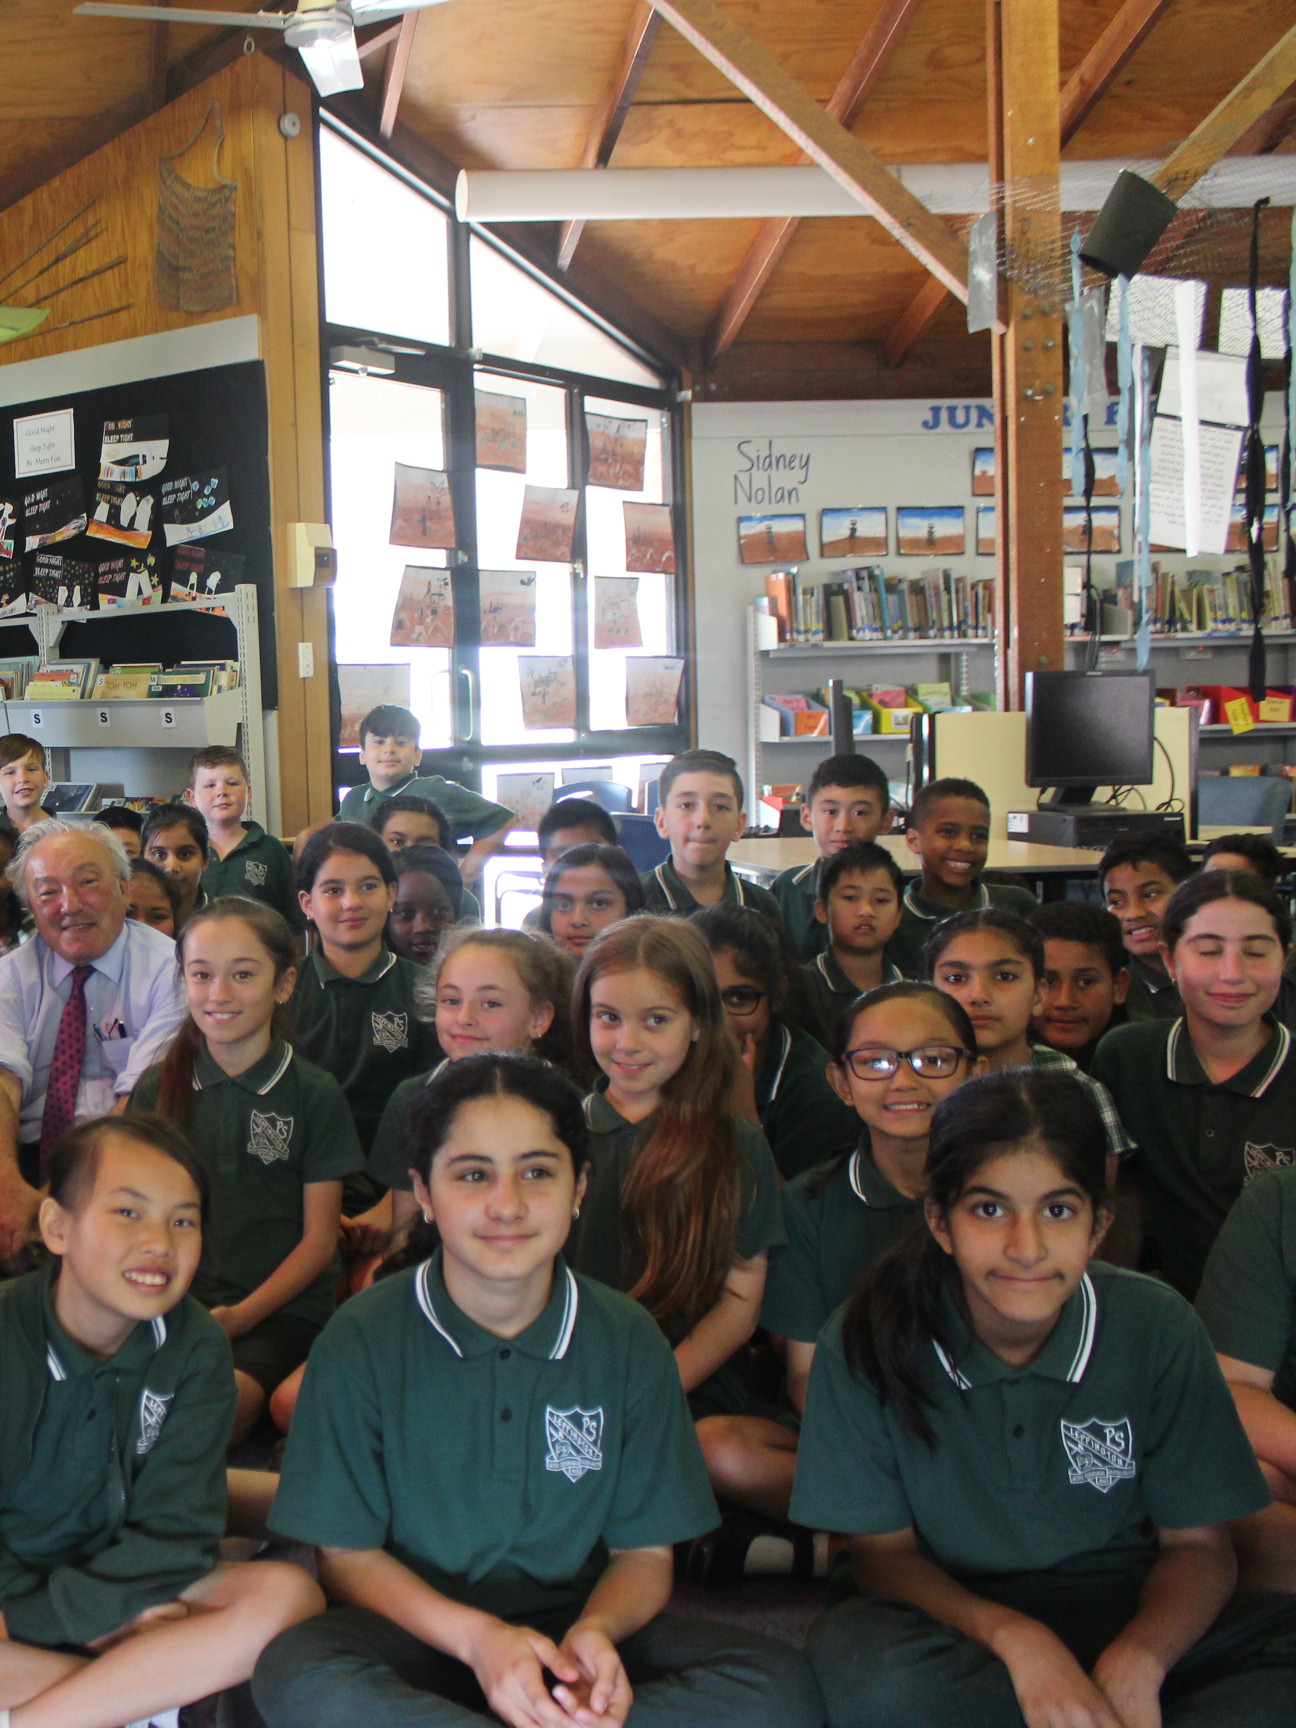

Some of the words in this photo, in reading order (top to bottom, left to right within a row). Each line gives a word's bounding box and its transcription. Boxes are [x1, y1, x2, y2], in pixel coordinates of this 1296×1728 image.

[40, 424, 56, 434] Night
[104, 435, 119, 443] SLEEP
[120, 433, 133, 442] TIGHT
[43, 441, 56, 450] Tight
[50, 454, 61, 463] Fox
[737, 440, 811, 484] Sidney
[734, 474, 801, 505] Nolan
[162, 494, 176, 505] SLEEP
[34, 714, 41, 724] S
[100, 712, 108, 723] S
[164, 712, 173, 724] S
[276, 1121, 288, 1139] PS
[582, 1416, 598, 1442] PS
[554, 1414, 594, 1457] LEPPINGTON
[1103, 1427, 1126, 1452] PS
[1070, 1427, 1124, 1467] LEPPINGTON
